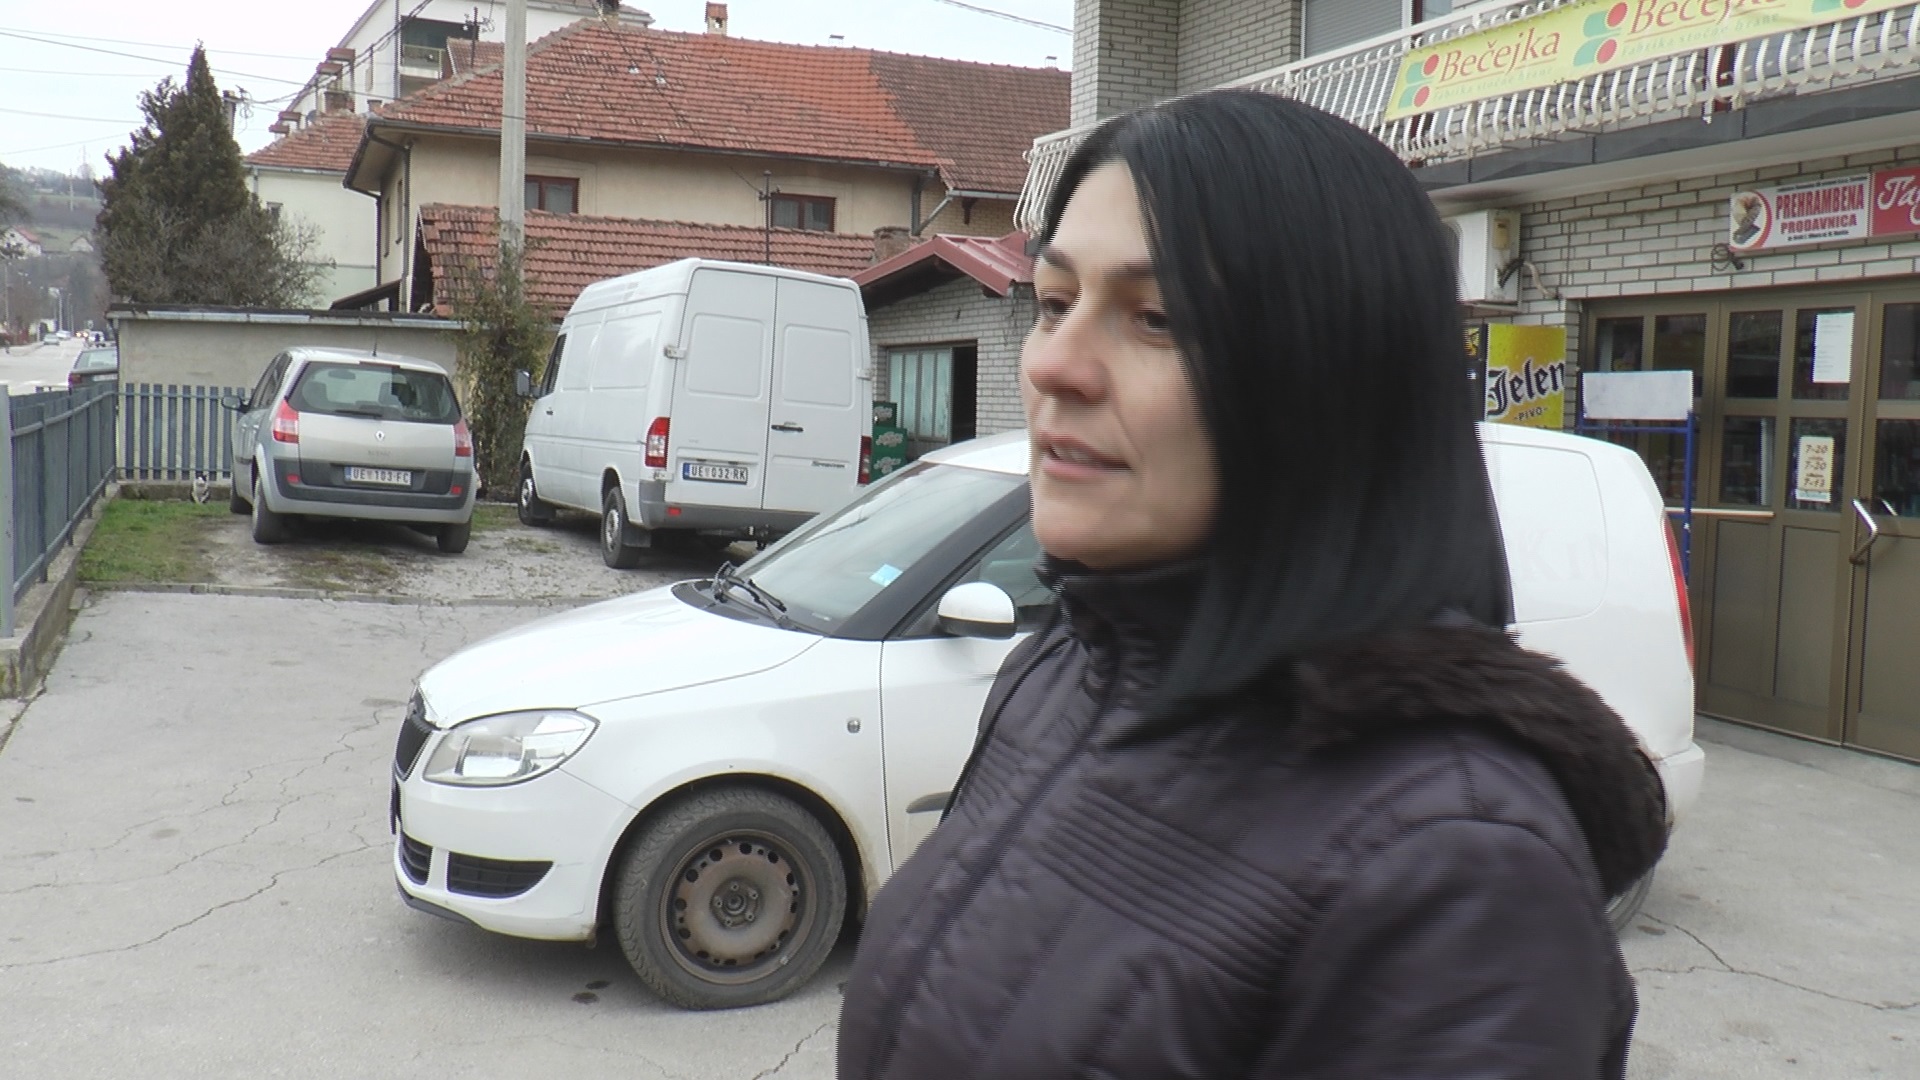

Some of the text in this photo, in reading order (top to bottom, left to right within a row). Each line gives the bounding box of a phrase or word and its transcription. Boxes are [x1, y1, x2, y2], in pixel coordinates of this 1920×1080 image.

[1439, 27, 1561, 83] Bečejka
[1775, 183, 1865, 220] PREHRAMBENA
[1780, 214, 1858, 235] PRODAVNICA
[1486, 358, 1565, 417] Jelen
[691, 465, 704, 477] UE
